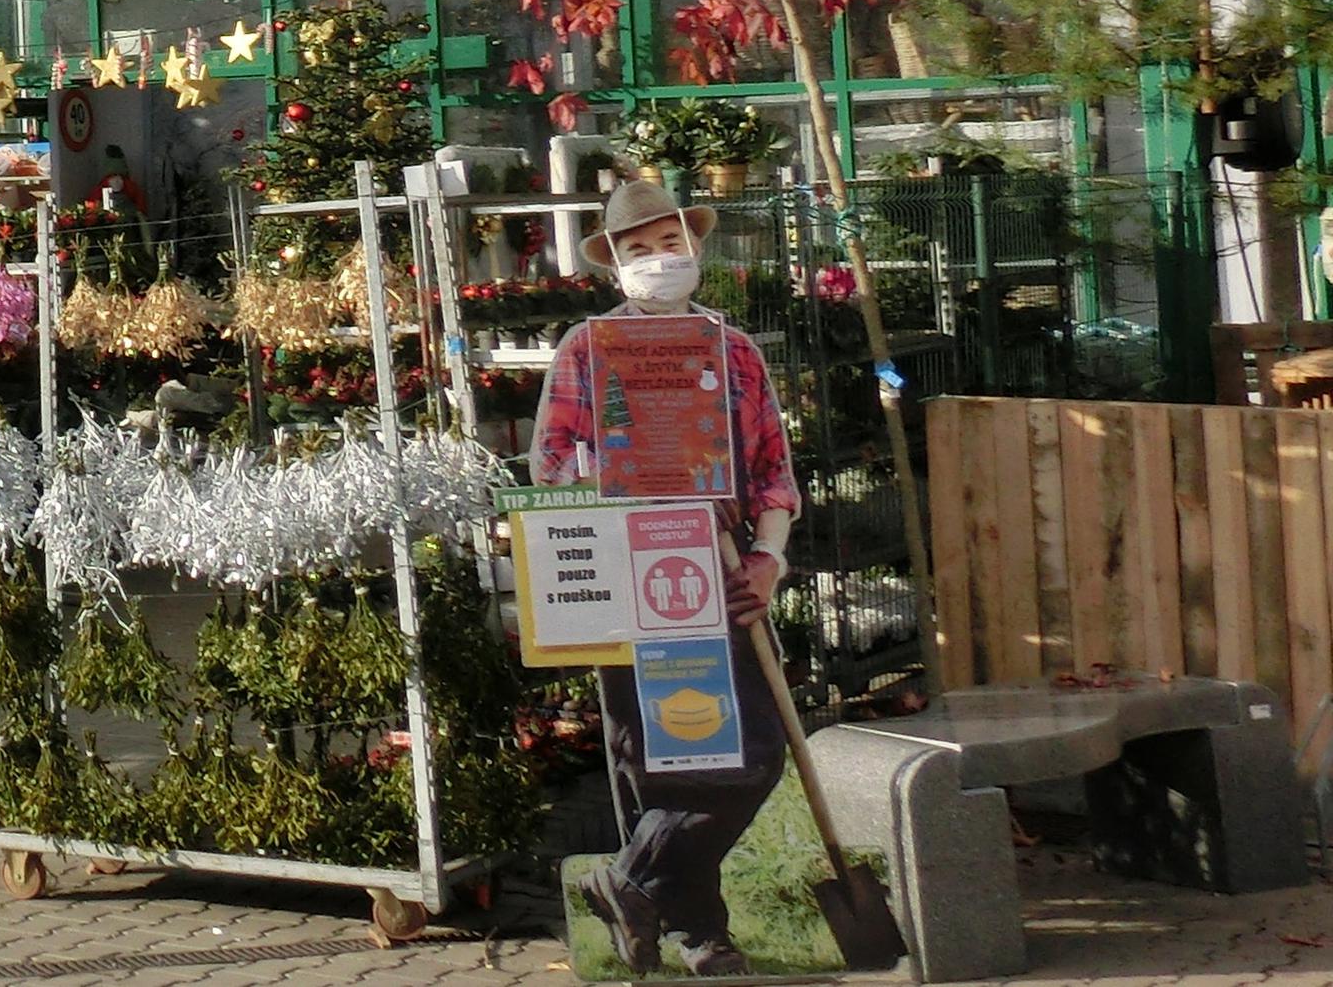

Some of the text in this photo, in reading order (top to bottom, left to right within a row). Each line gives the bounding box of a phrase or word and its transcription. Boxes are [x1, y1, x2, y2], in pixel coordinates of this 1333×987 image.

[501, 494, 528, 509] TIP
[547, 524, 597, 540] Prosím,
[649, 531, 692, 541] ODSTUP
[557, 547, 593, 561] vstup
[558, 568, 597, 583] pouze
[546, 587, 611, 604] s rouškou
